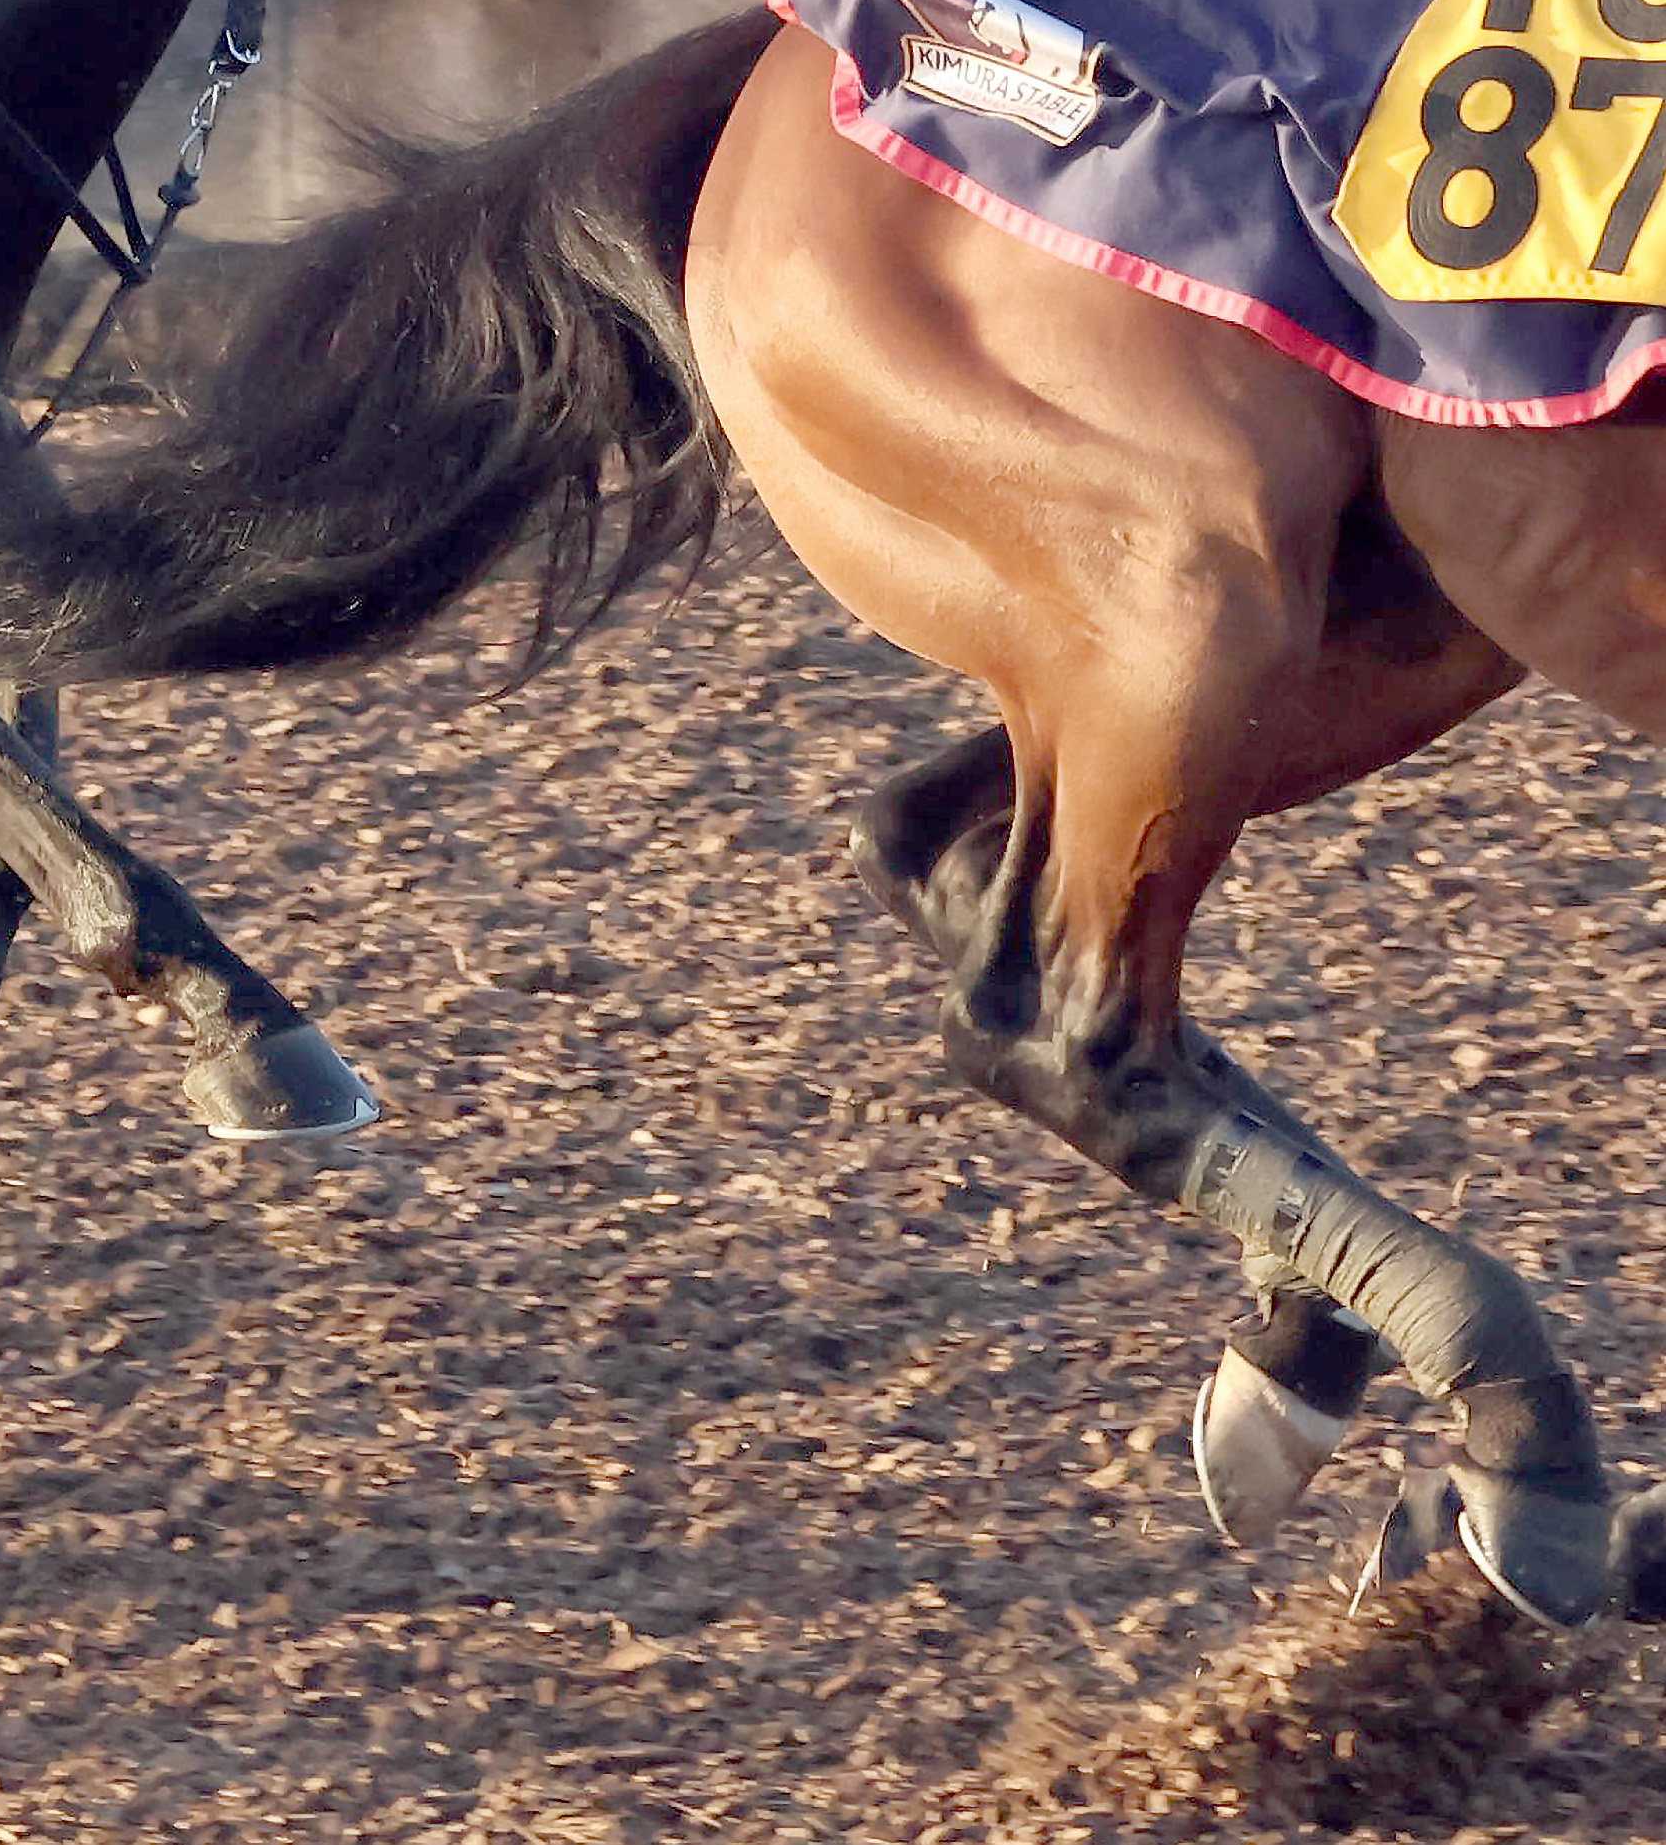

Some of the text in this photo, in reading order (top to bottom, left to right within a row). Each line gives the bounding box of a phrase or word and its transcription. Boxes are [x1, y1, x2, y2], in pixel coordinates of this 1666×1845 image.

[918, 46, 1009, 99] KIMURA
[1010, 81, 1087, 122] STABLE
[1407, 45, 1666, 274] 87
